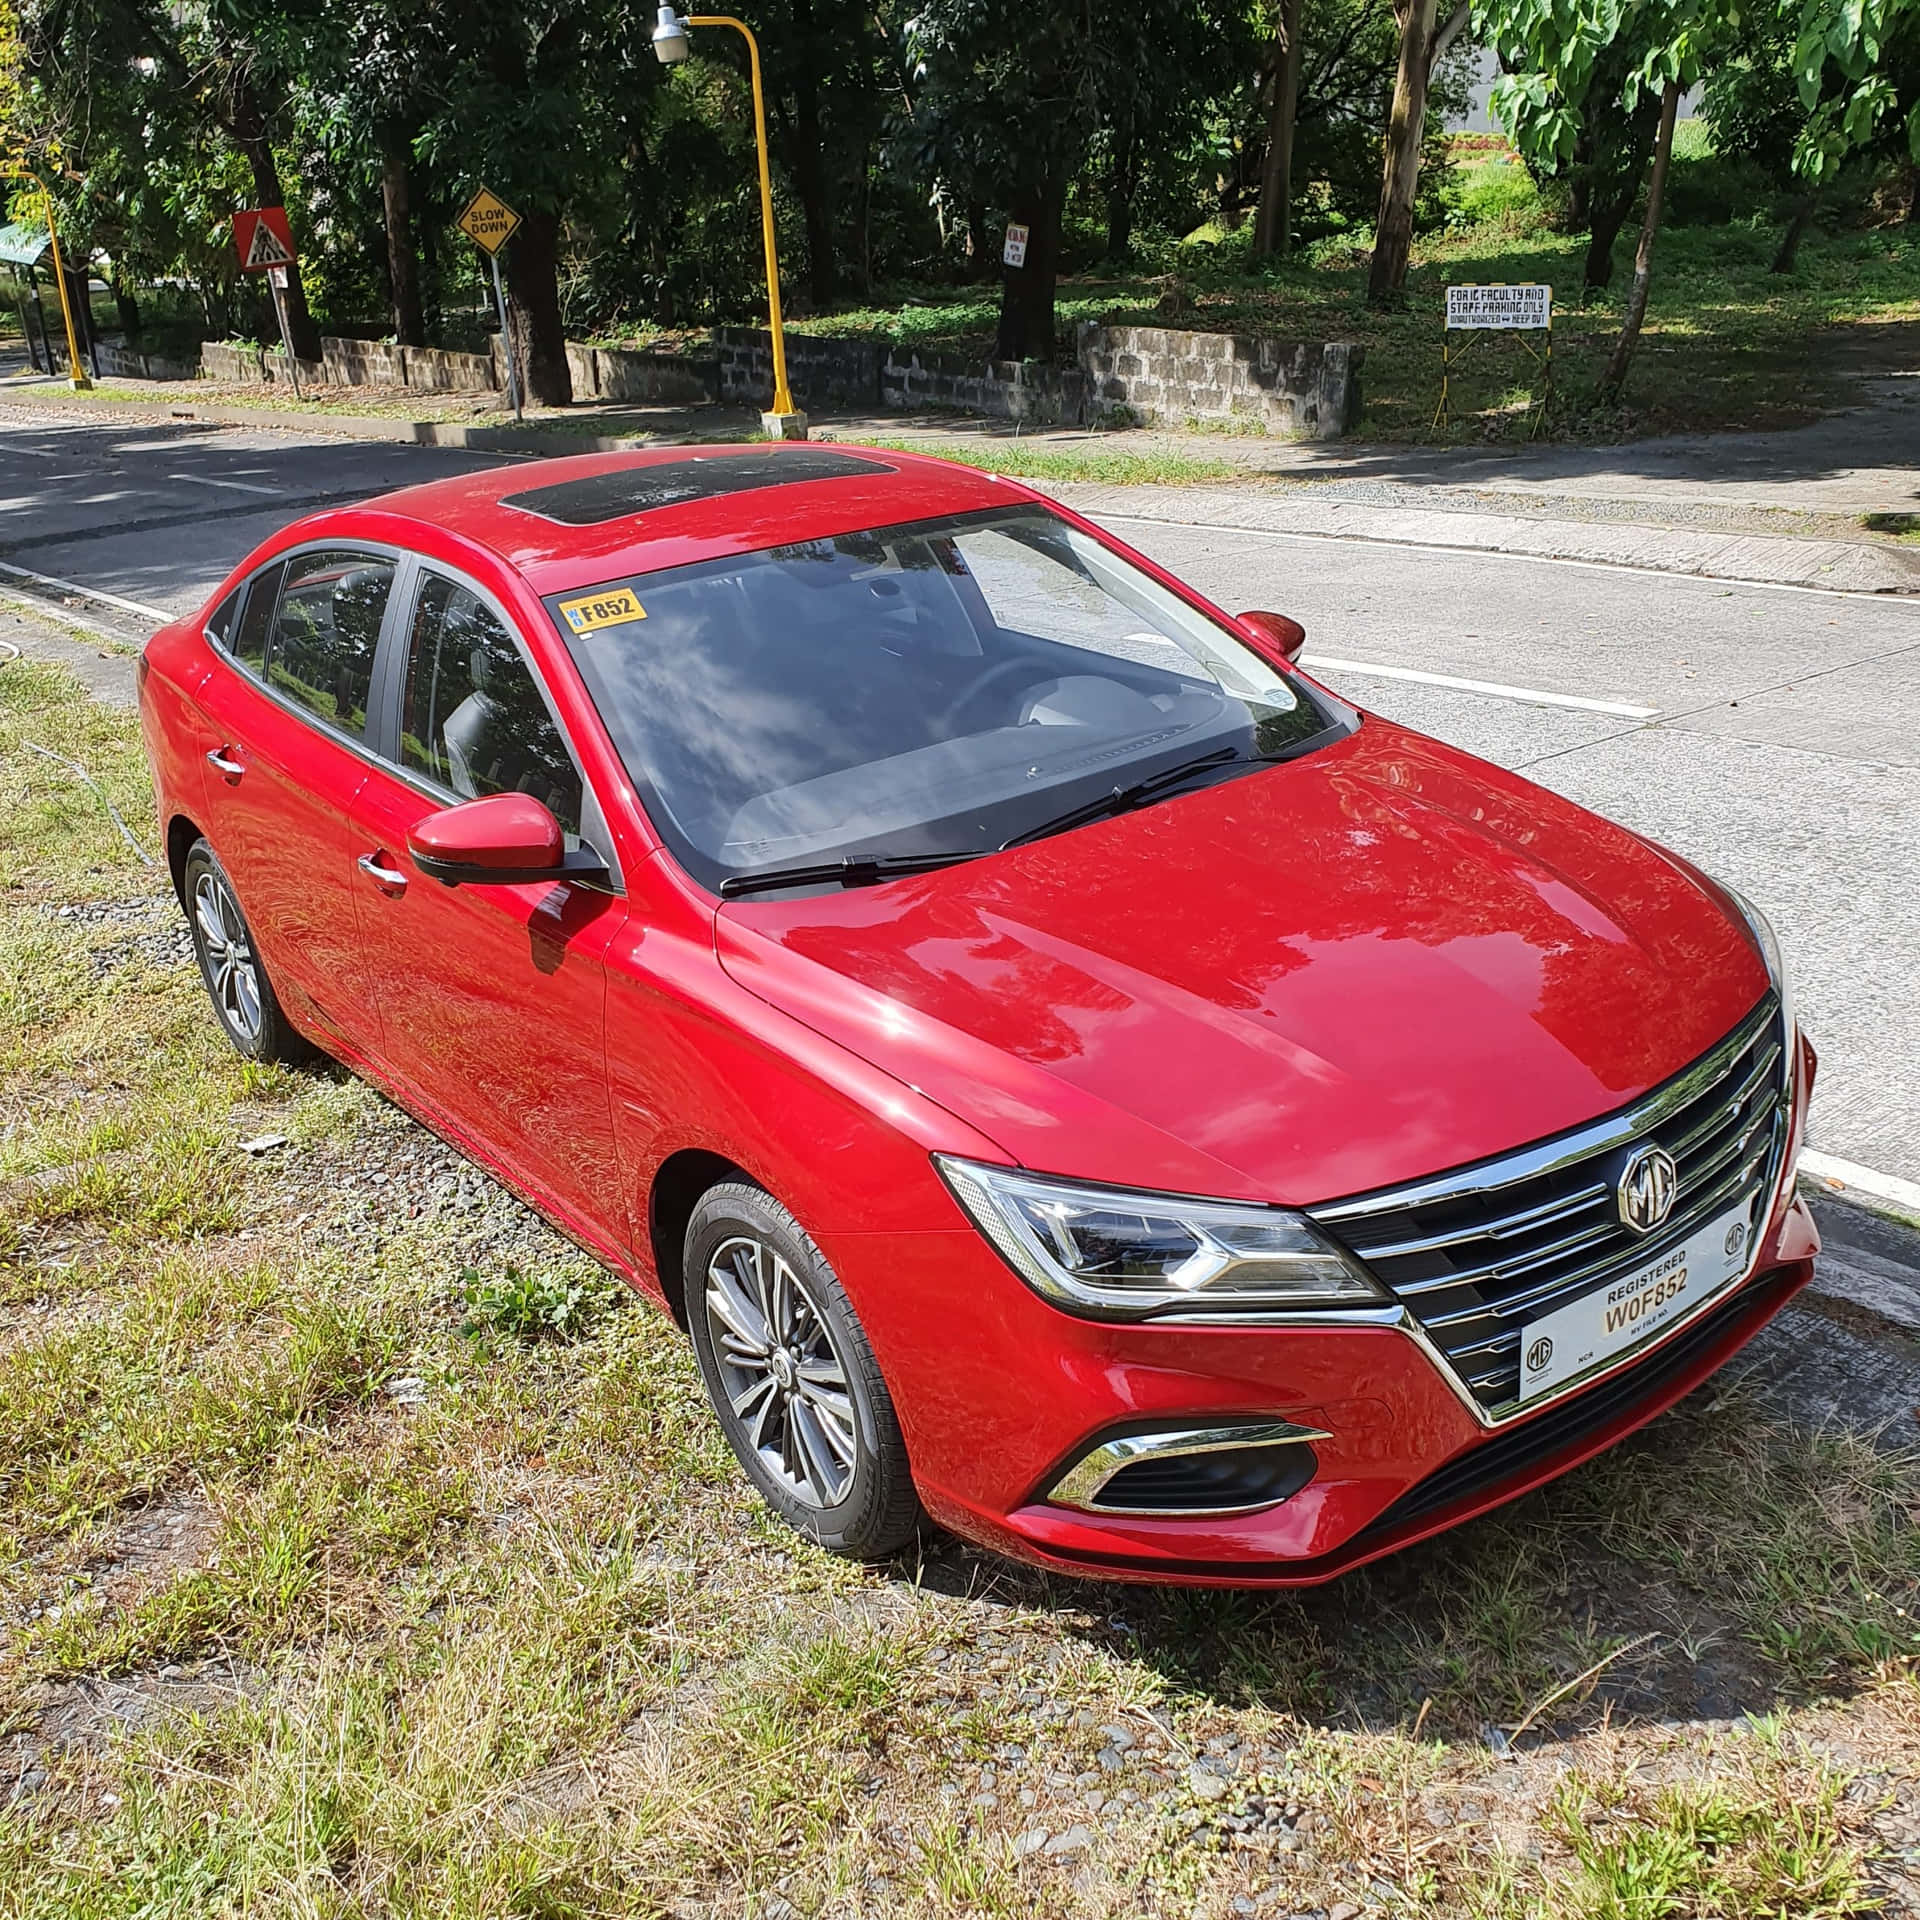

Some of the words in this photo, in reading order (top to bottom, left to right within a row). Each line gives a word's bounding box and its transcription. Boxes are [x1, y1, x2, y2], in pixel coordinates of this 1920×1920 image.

[470, 208, 505, 222] SLOW
[471, 221, 508, 234] DOWN
[1450, 289, 1468, 301] FOR
[1481, 288, 1523, 301] FACULTY
[1525, 288, 1544, 300] AND
[1450, 302, 1481, 314] STAFF
[1482, 301, 1522, 313] PARKING
[1523, 301, 1544, 313] ONLY
[1450, 314, 1501, 324] UNAUTHORIZED
[1511, 314, 1530, 324] KEEP
[1531, 314, 1545, 324] OUT
[580, 598, 636, 622] F852
[1626, 1152, 1673, 1226] MG
[1607, 1250, 1686, 1305] REGISTERED
[1643, 1316, 1657, 1329] FILE
[1578, 1351, 1594, 1364] NCR
